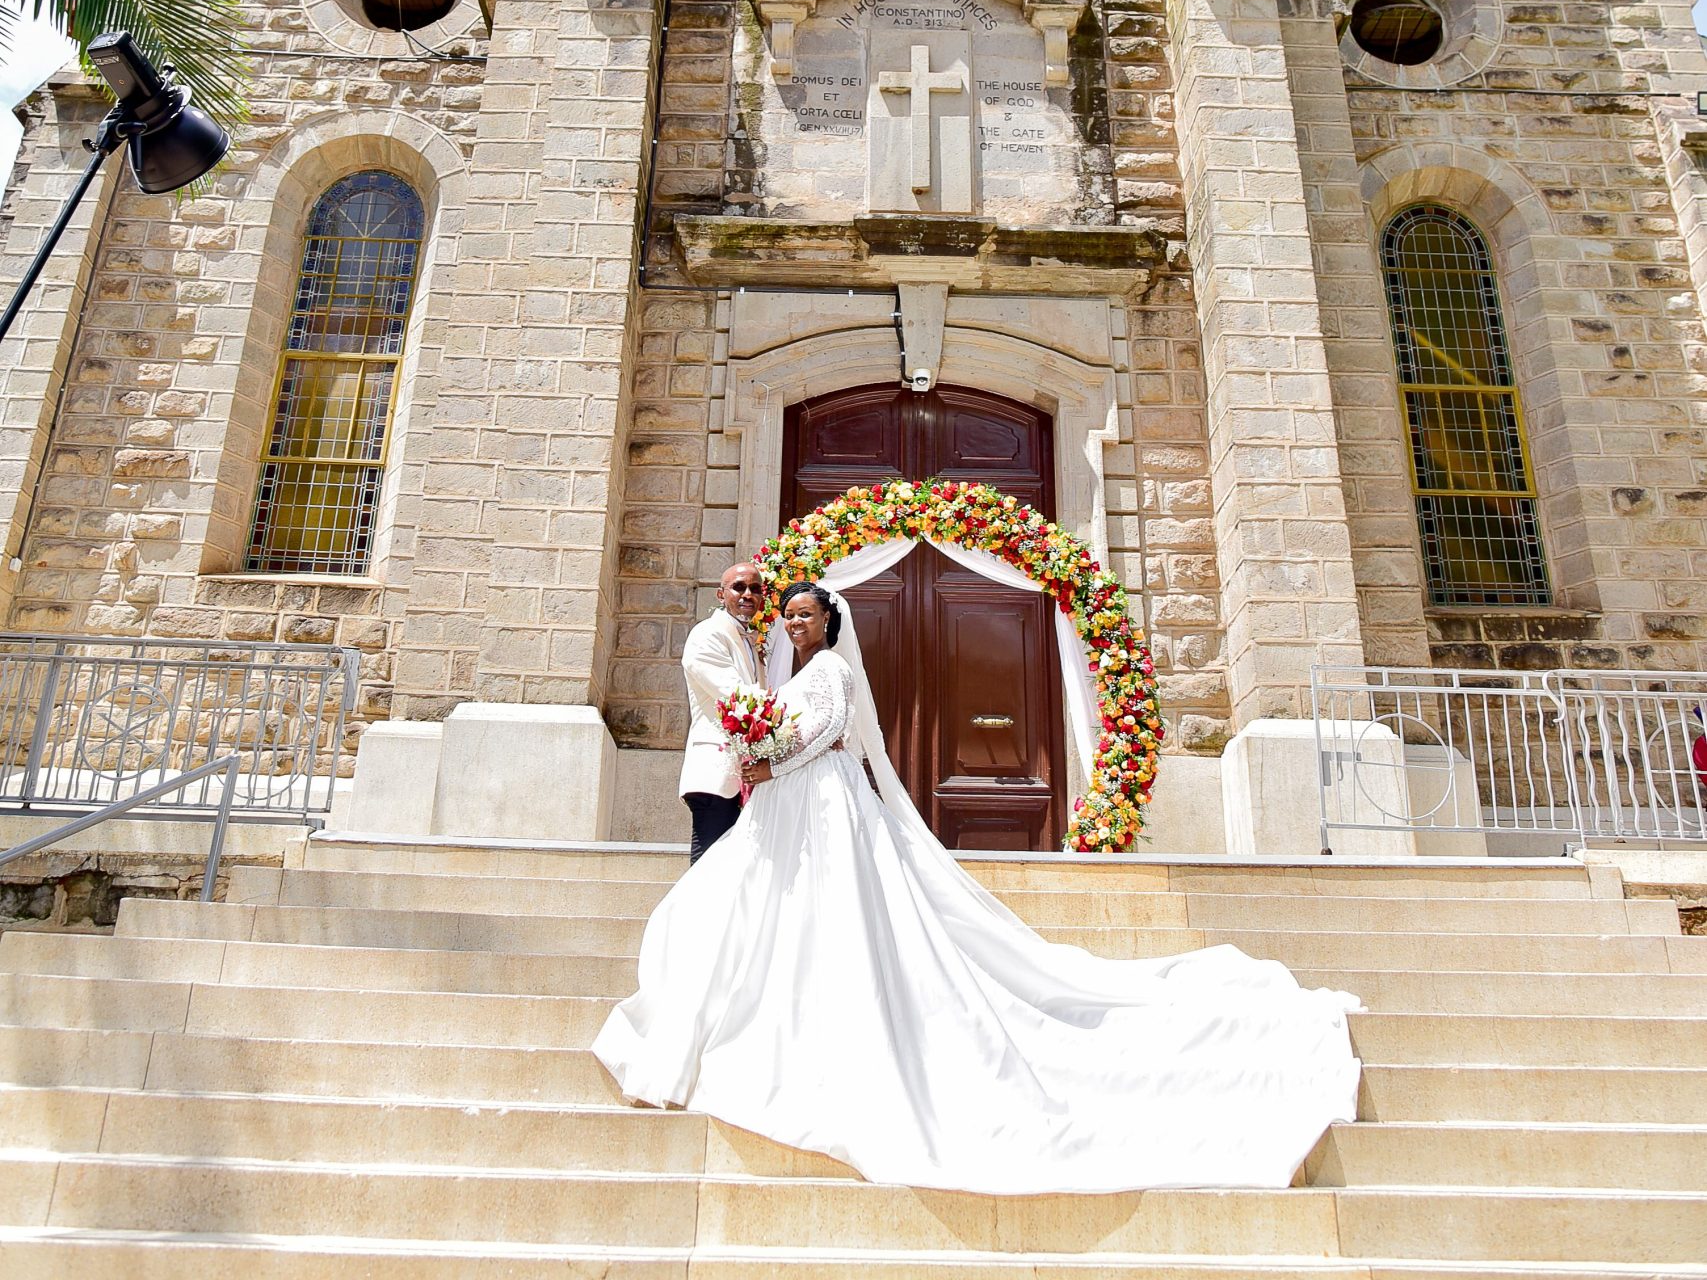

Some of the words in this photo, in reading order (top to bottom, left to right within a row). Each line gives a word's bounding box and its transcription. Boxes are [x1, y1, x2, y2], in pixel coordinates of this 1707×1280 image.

[873, 5, 966, 19] (CONSTANTINO)
[836, 12, 854, 29] IN
[924, 18, 943, 27] 313
[791, 76, 834, 85] DOMUS
[841, 77, 862, 86] DEI
[975, 80, 1000, 90] THE
[1003, 81, 1042, 91] HOUSE
[823, 92, 840, 101] ET
[985, 96, 1000, 105] OF
[1007, 97, 1034, 107] GOD
[1004, 112, 1013, 121] &
[978, 126, 1000, 136] THE
[1011, 128, 1045, 139] GATE
[980, 142, 994, 151] OF
[1001, 143, 1043, 153] HEAVEN
